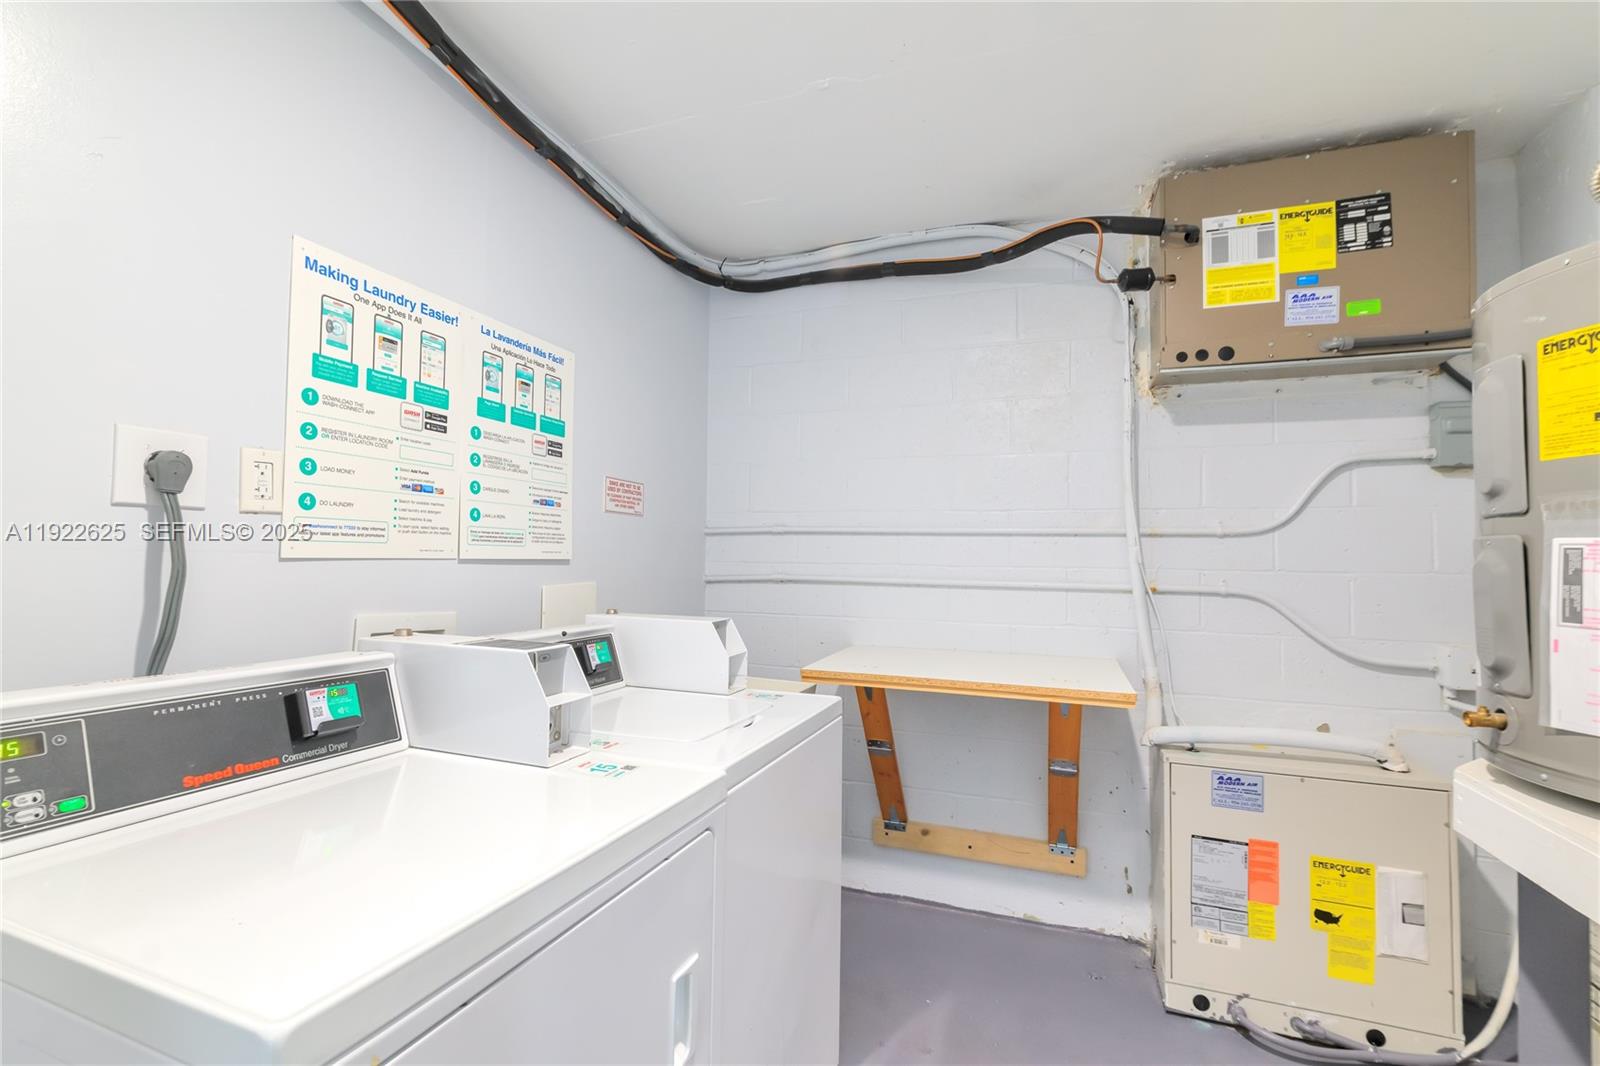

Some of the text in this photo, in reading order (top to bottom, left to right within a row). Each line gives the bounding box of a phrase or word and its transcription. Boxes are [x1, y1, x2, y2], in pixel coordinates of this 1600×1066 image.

[1280, 207, 1333, 221] ENERGYGUIDE
[304, 255, 460, 327] Making Laundry Easier!
[353, 293, 370, 306] One
[372, 301, 386, 312] App
[388, 304, 406, 318] Does
[414, 315, 422, 325] All
[480, 324, 491, 337] La
[307, 391, 313, 401] 1
[322, 394, 354, 406] DOWNLOAD
[305, 425, 313, 436] 2
[321, 427, 347, 436] REGISTER
[473, 455, 478, 464] 2
[304, 461, 312, 471] 3
[336, 467, 356, 475] MONEY
[303, 496, 311, 506] 4
[153, 693, 267, 716] PERMANENT PRESS
[182, 741, 348, 789] Speed Queen Commercial Dryer
[1312, 860, 1371, 876] ENERGYGUIDE
